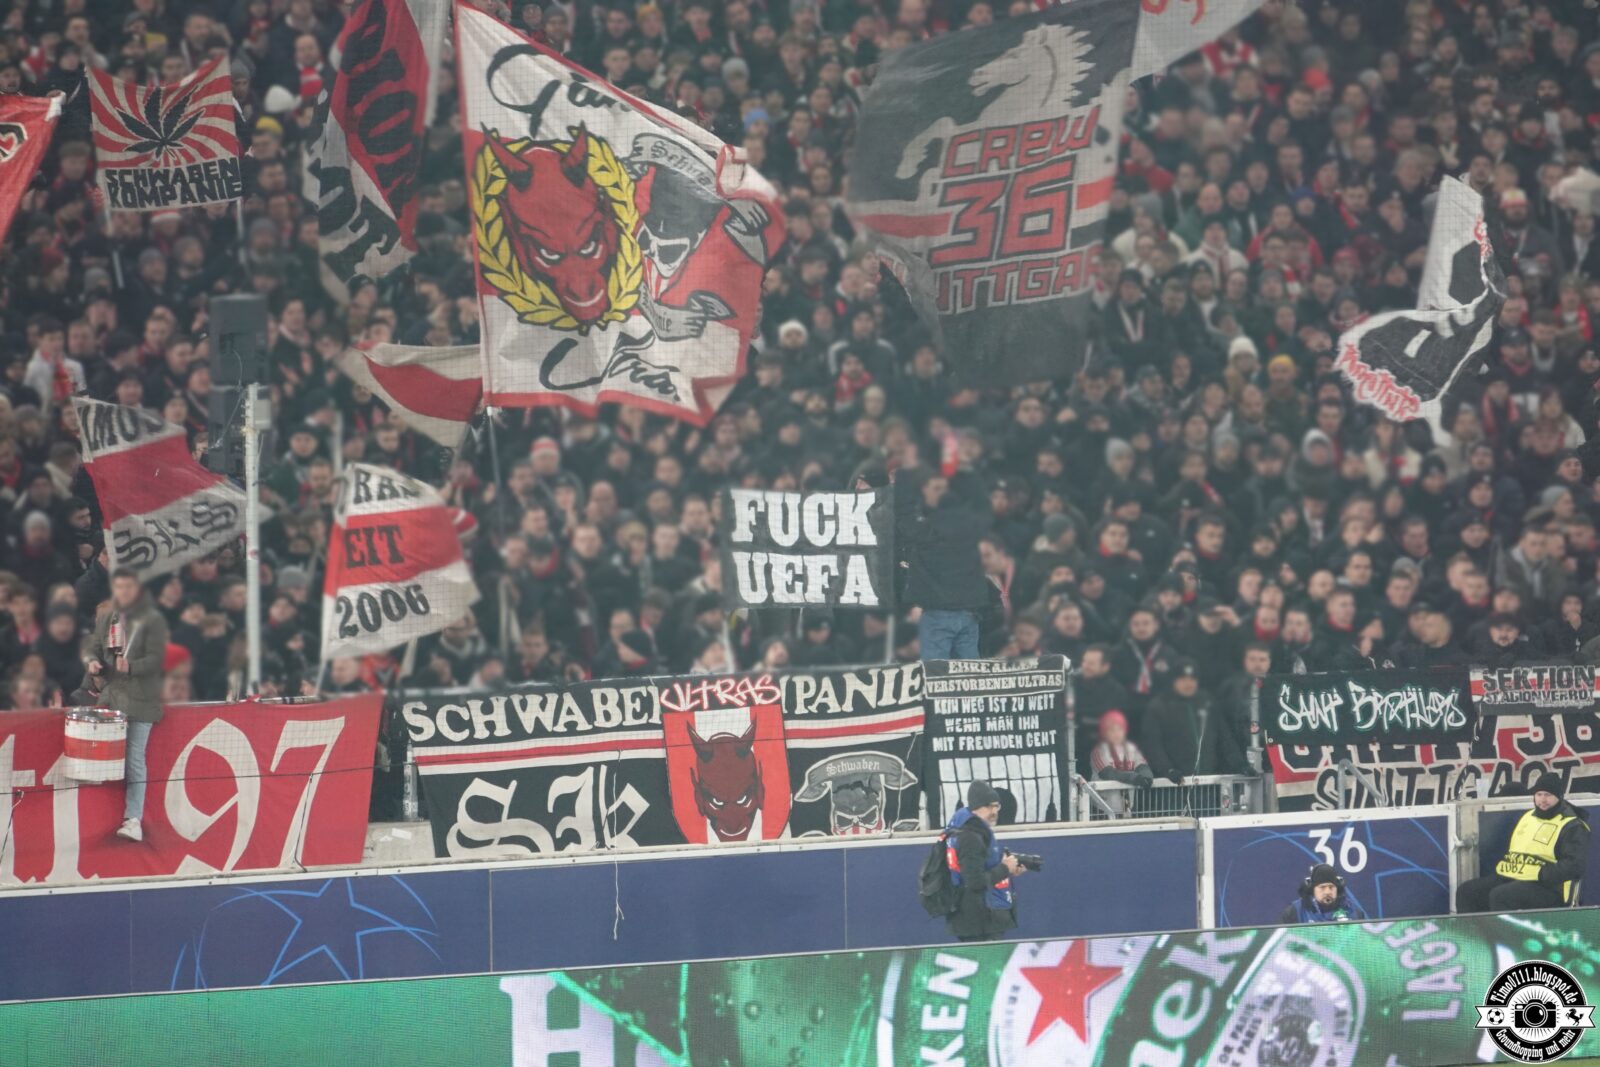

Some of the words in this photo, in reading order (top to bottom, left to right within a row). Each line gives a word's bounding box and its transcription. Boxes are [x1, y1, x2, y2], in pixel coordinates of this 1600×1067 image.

[104, 156, 240, 188] SCHWABEN
[108, 178, 243, 209] KOMPANIE
[930, 153, 1076, 268] 36
[730, 488, 878, 547] FUCK
[731, 551, 880, 606] UEFA
[335, 583, 430, 639] 2006
[948, 661, 991, 674] EHRE
[1482, 664, 1595, 692] SEKTION
[660, 674, 783, 712] ULTRAS
[927, 678, 1017, 693] VERSTORBENEN
[1018, 674, 1063, 687] ULTRAS
[933, 697, 959, 715] KEIN
[961, 697, 985, 714] WEG
[988, 696, 1007, 714] IST
[1011, 696, 1025, 712] ZU
[1028, 693, 1055, 712] WEIT
[944, 716, 981, 733] WENN
[932, 736, 955, 753] MIT
[958, 733, 1023, 752] FREUNDEN
[1025, 729, 1057, 748] GEHT
[825, 759, 881, 776] Schwaben
[164, 716, 346, 876] 97
[1308, 827, 1368, 874] 36
